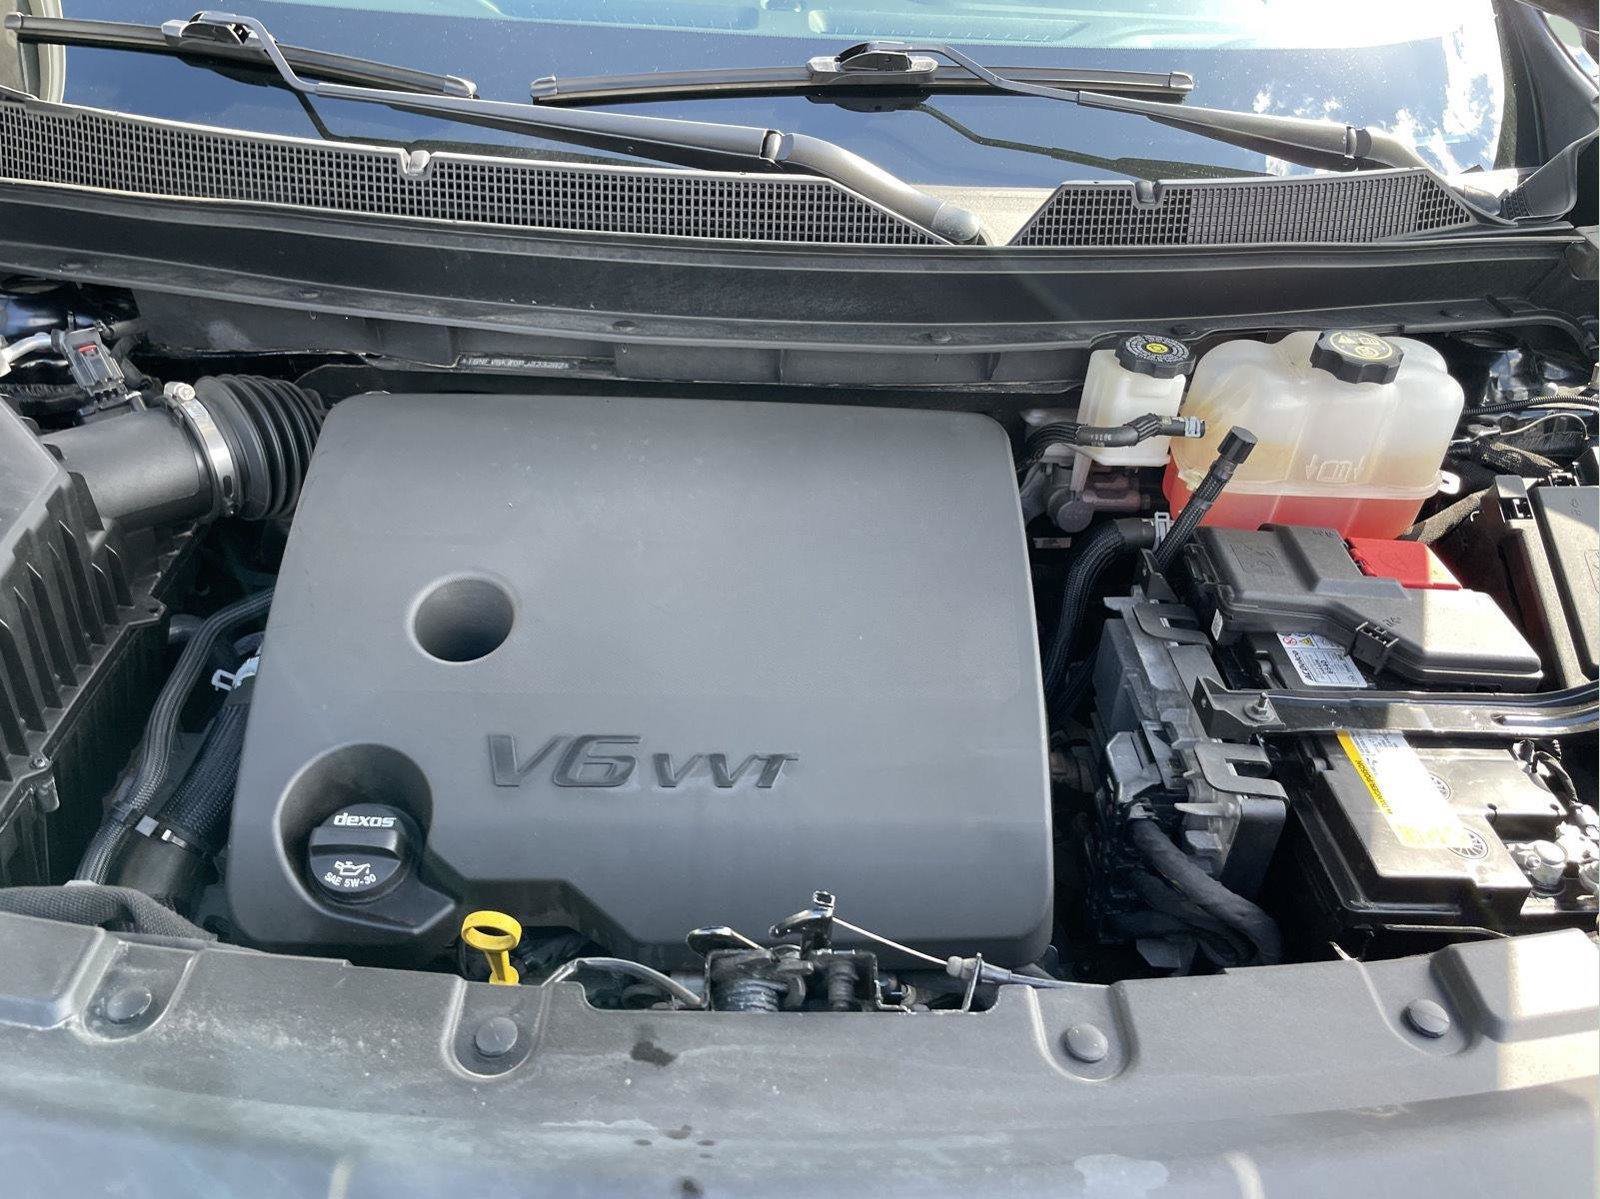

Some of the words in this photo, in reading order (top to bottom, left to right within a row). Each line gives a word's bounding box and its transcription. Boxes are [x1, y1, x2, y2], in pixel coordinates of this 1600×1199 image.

[487, 733, 642, 787] V6
[652, 752, 799, 788] VVT
[333, 812, 397, 828] dexos
[324, 871, 343, 887] SAE
[344, 873, 377, 888] 5W-30
